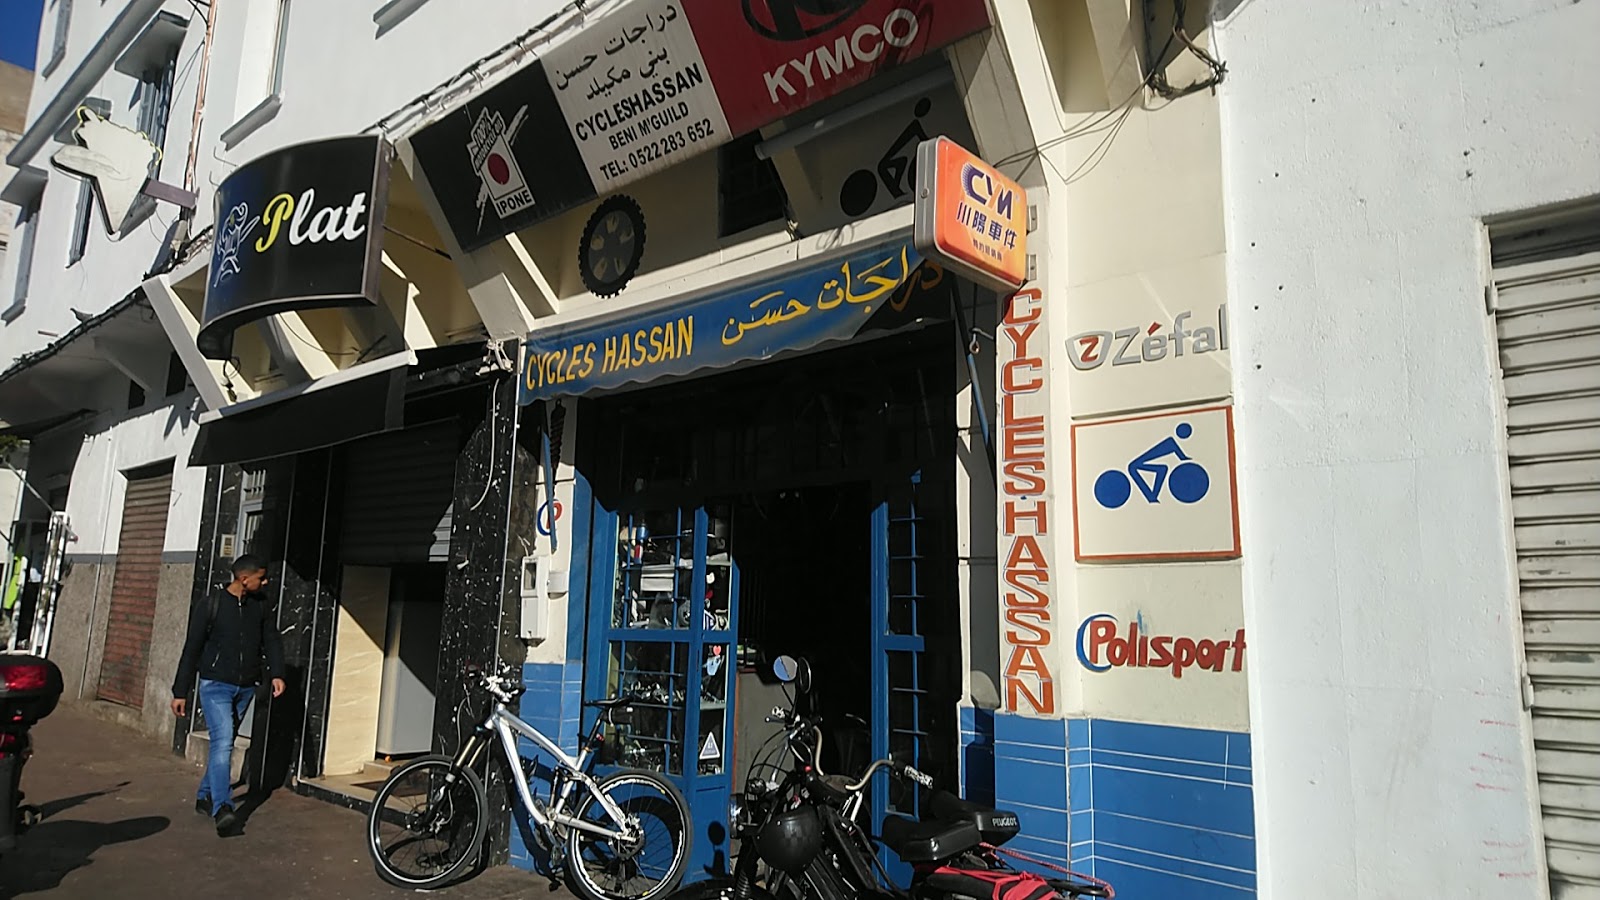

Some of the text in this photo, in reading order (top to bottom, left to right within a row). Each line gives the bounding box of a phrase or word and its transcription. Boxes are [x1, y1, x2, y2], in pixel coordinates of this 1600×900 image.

[556, 4, 677, 91] دراجات حسن
[639, 47, 671, 79] بني
[763, 8, 919, 104] KYMCO
[599, 159, 629, 180] TEL:
[687, 118, 714, 143] 652
[608, 125, 638, 150] BENI
[255, 188, 366, 253] Plat
[496, 190, 532, 215] IPONE
[526, 315, 694, 391] CYCLES HASSAN
[1112, 303, 1229, 367] Zéfal
[1086, 618, 1247, 679] Polisport
